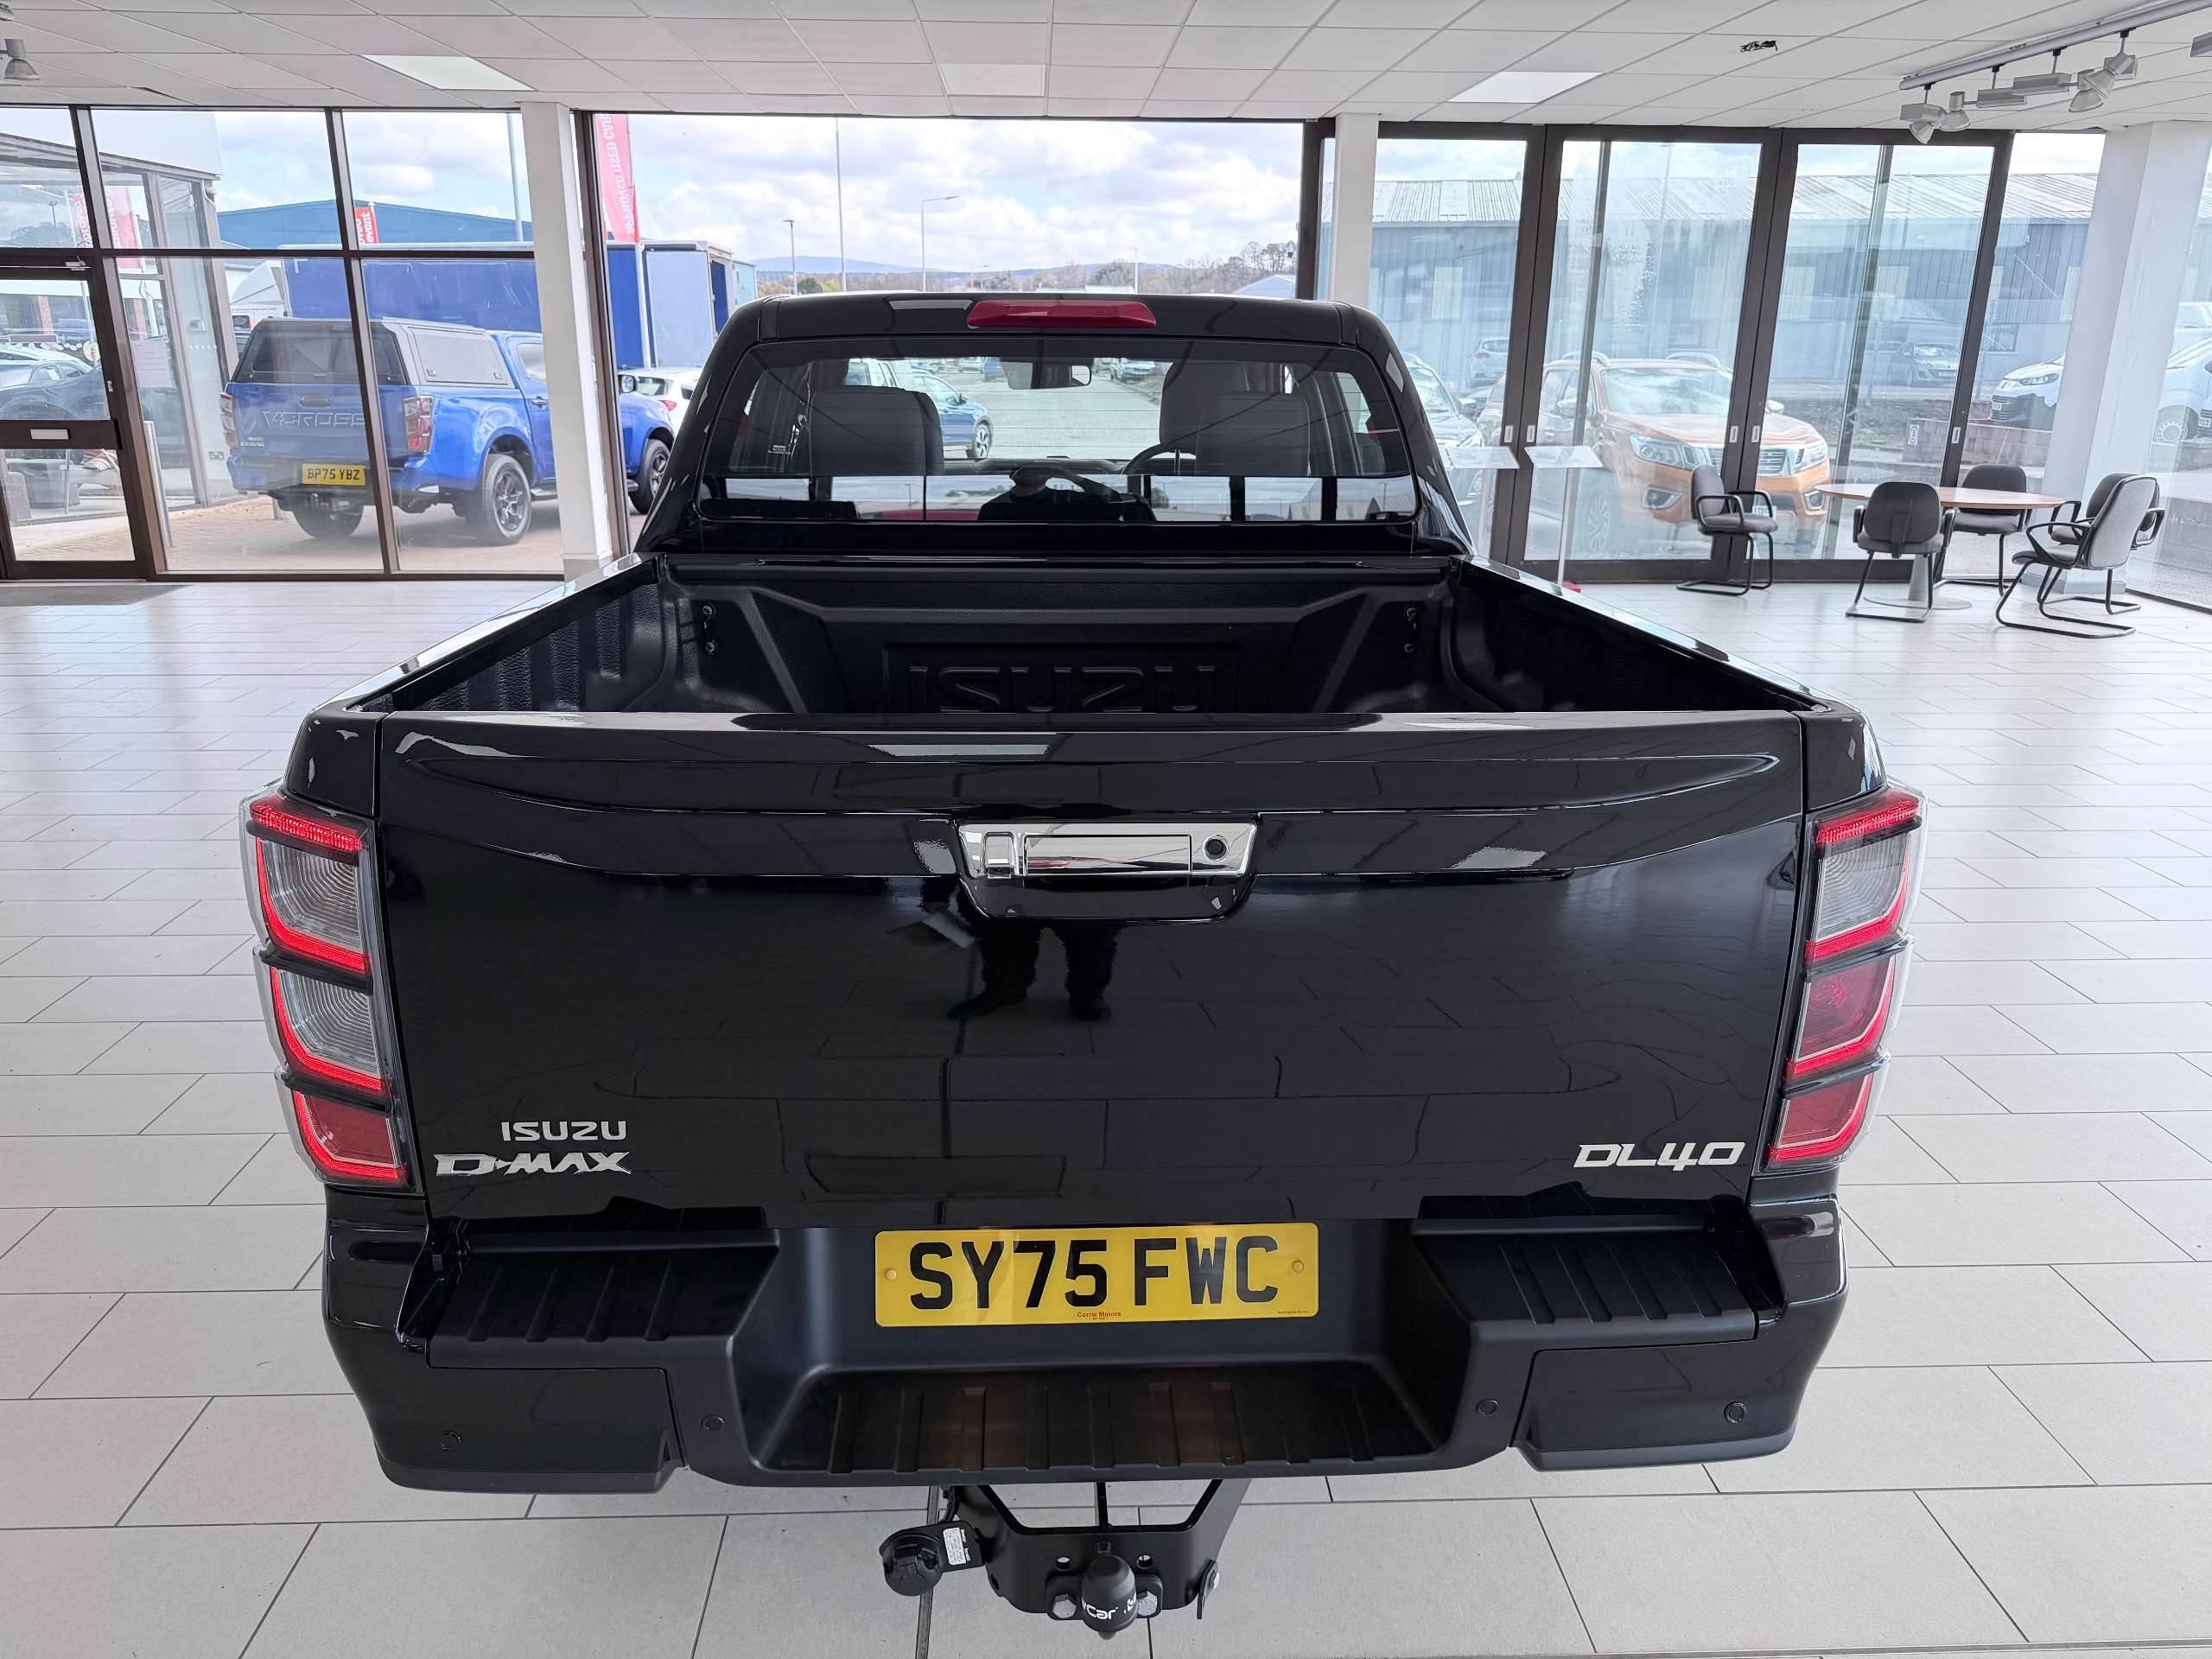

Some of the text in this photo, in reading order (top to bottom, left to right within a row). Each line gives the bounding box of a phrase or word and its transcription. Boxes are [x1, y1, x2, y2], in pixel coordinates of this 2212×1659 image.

[308, 468, 360, 480] BP75 YBZ
[908, 665, 1215, 714] ISUZU
[500, 1121, 626, 1141] ISUZU
[433, 1151, 632, 1177] D-MAX
[1573, 1141, 1746, 1172] DL40
[909, 1235, 1279, 1310] SY75 FWC
